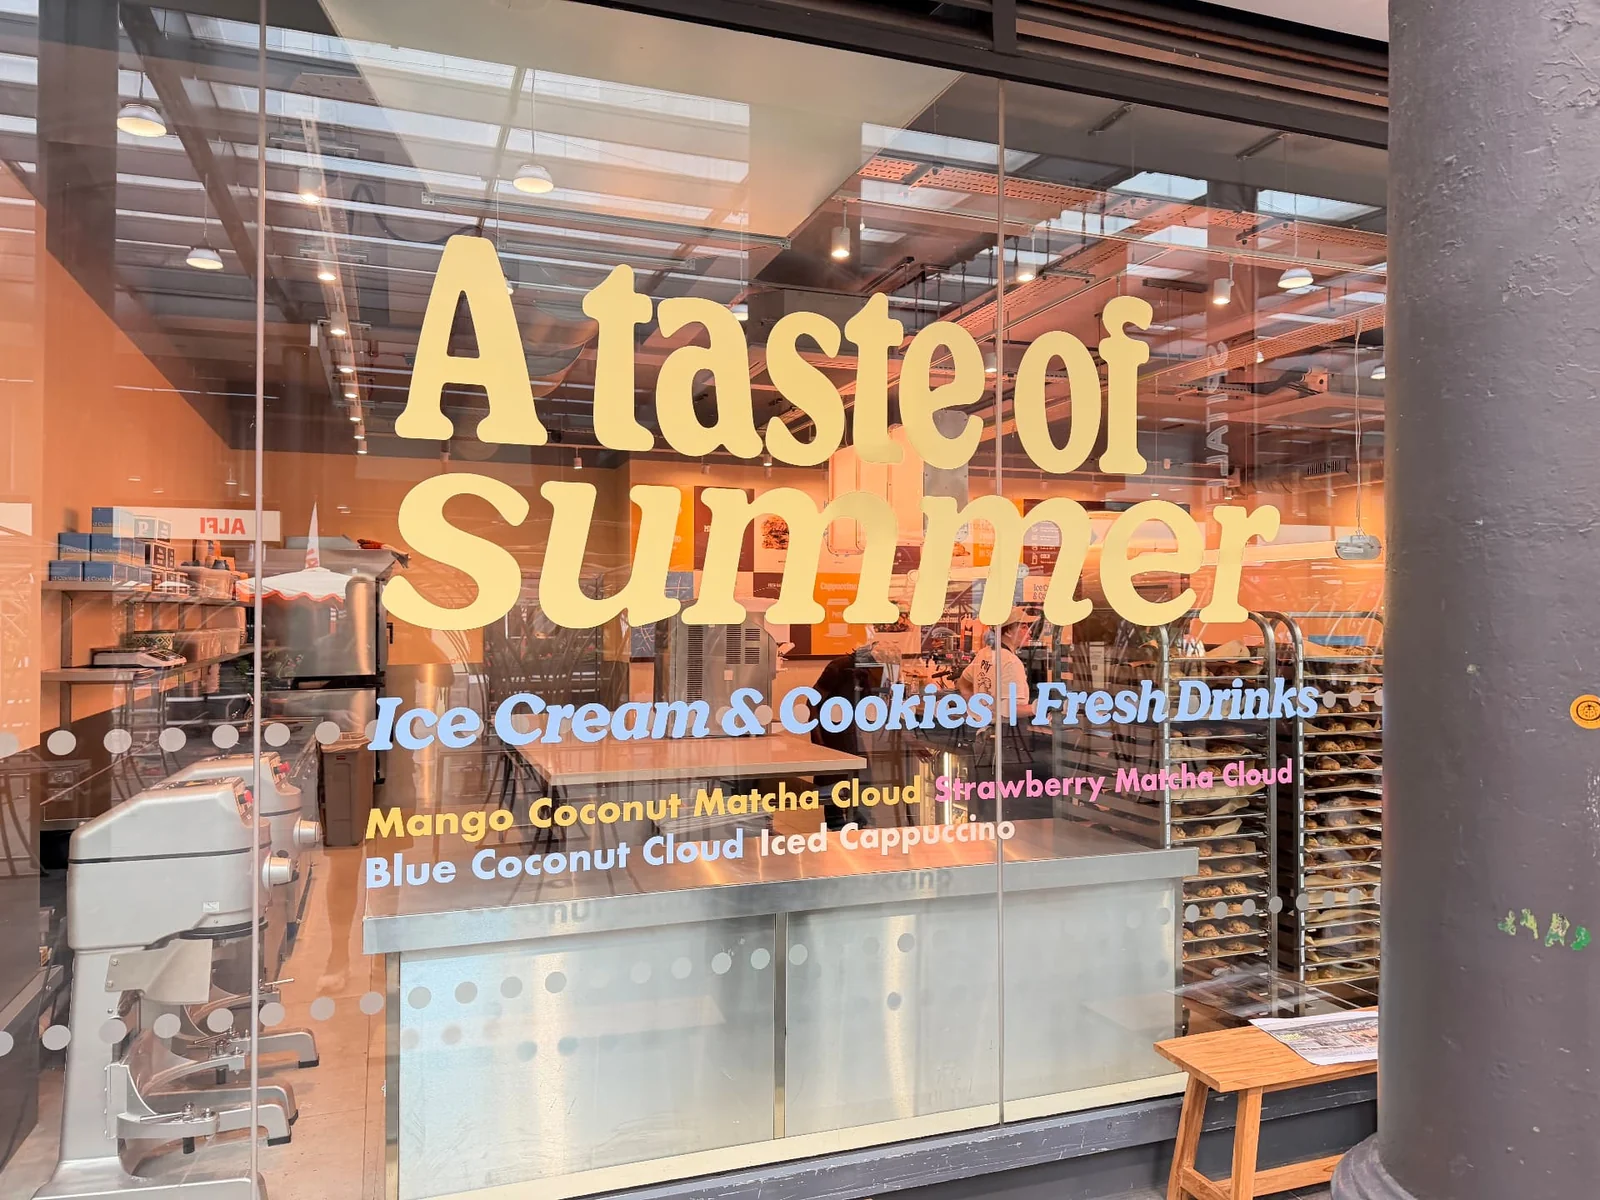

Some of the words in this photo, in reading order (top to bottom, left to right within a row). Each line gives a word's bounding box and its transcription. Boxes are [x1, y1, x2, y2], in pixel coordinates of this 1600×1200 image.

[395, 234, 548, 446] A
[582, 264, 985, 470] taste
[1014, 295, 1154, 476] of
[367, 696, 481, 751] Ice
[494, 693, 709, 746] Cream
[721, 687, 765, 737] &
[779, 683, 994, 734] Cookies
[1031, 679, 1168, 726] Fresh
[1174, 677, 1319, 722] Drinks
[365, 807, 514, 843] Mango
[529, 793, 682, 829] Coconut
[693, 782, 820, 817] Matcha
[831, 775, 921, 808] Cloud
[934, 770, 1106, 802] Strawberry
[1114, 762, 1214, 794] Matcha
[1222, 757, 1294, 787] Cloud
[365, 853, 457, 889] Blue
[471, 841, 631, 881] Coconut
[642, 828, 744, 867] Cloud
[760, 822, 828, 858] Iced
[839, 814, 1016, 856] Cappuccino
